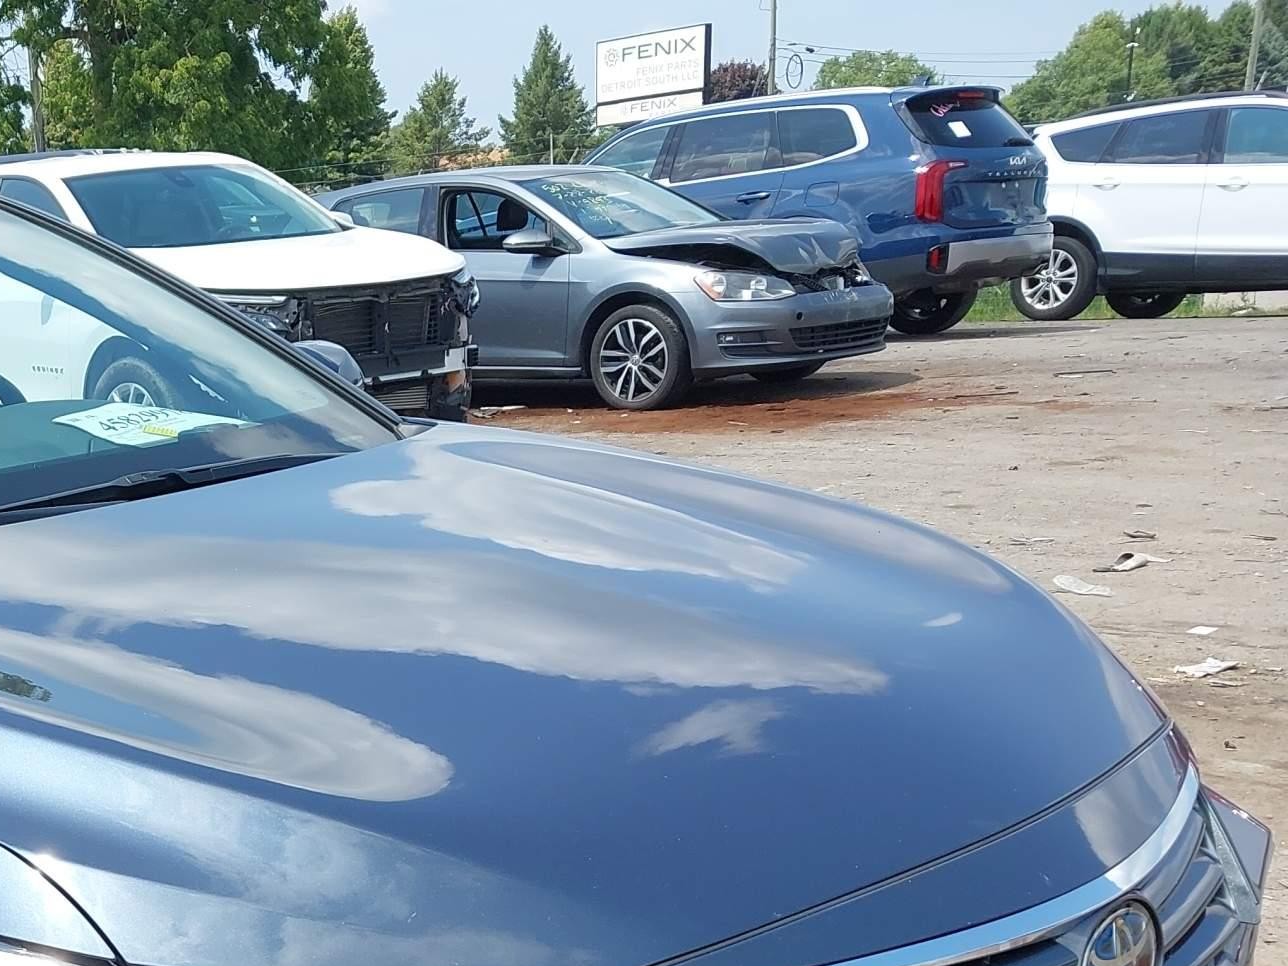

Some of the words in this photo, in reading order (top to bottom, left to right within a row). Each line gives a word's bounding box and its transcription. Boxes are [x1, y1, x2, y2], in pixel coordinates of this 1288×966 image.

[621, 36, 697, 62] FENIX
[636, 64, 666, 78] FENIX
[668, 58, 700, 72] PARTS
[600, 79, 642, 94] DETROIT
[645, 74, 678, 87] SOUTH
[630, 97, 677, 113] FENIX
